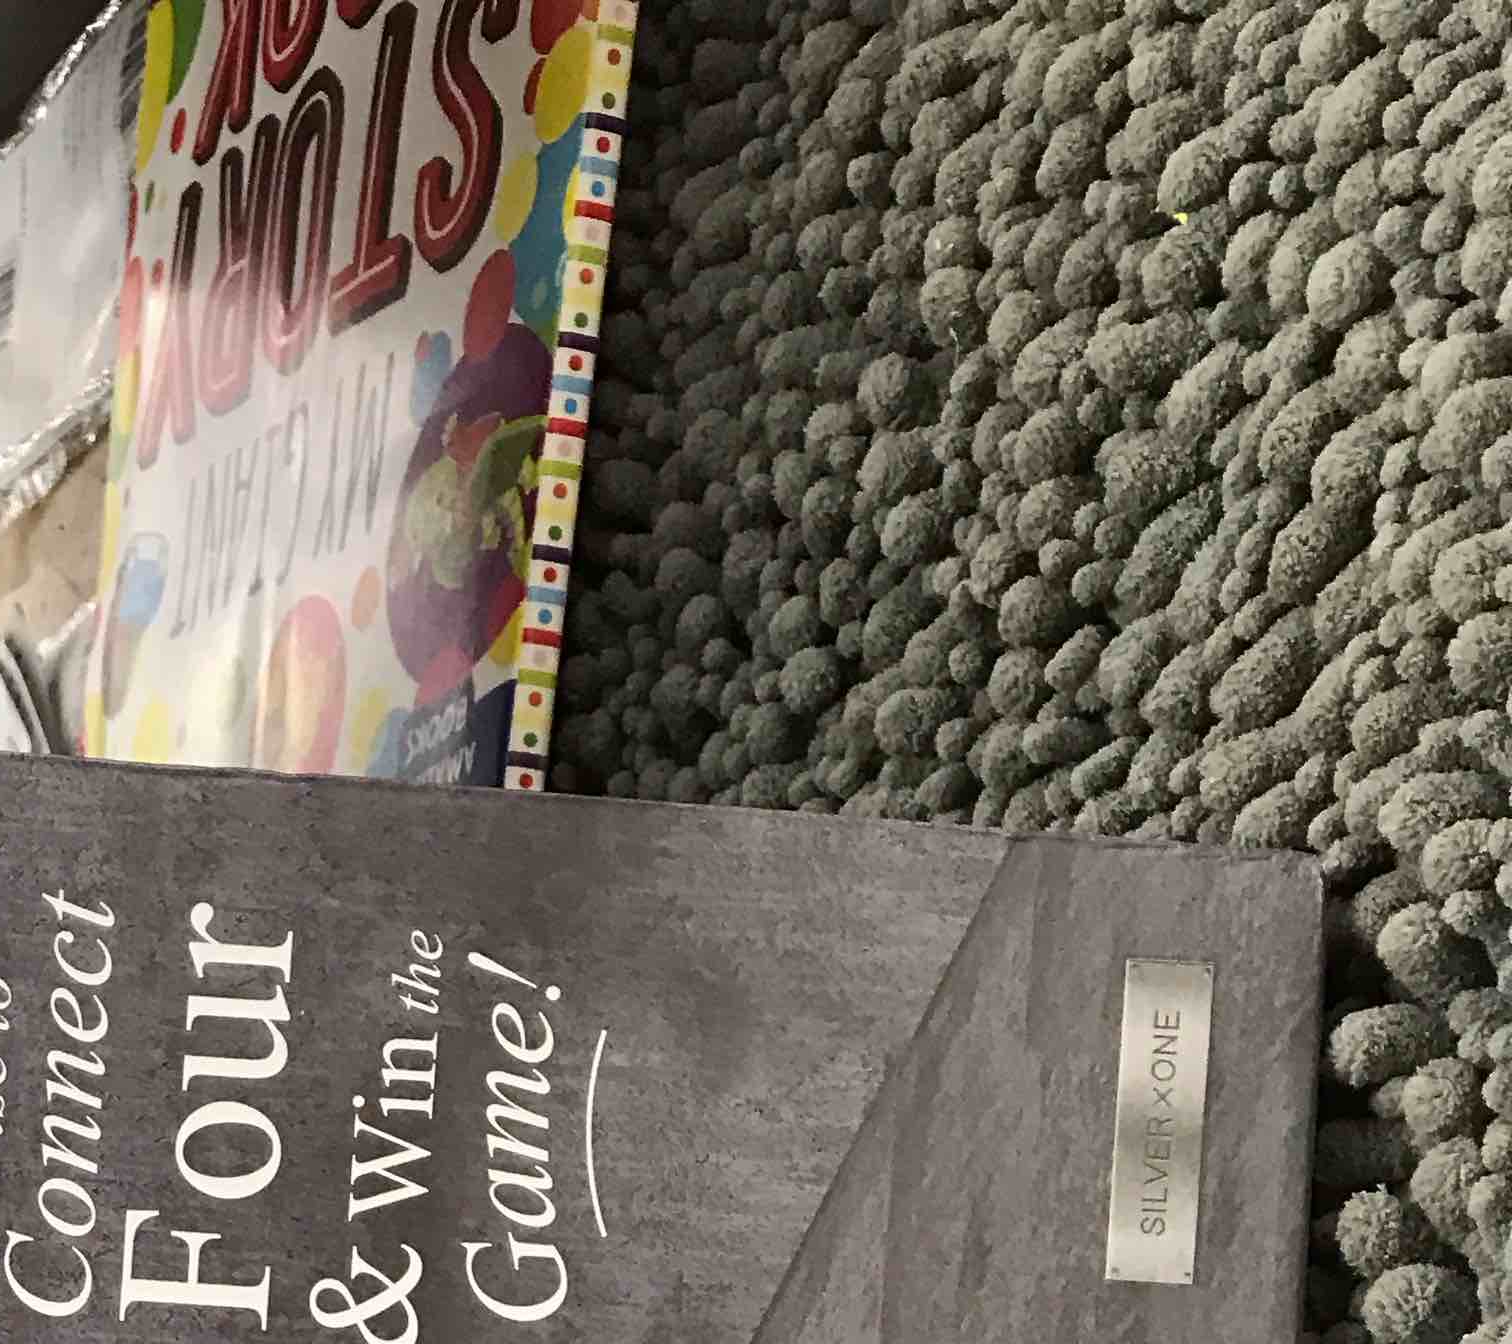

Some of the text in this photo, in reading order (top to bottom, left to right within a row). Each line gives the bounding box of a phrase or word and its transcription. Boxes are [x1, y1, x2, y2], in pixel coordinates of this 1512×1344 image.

[136, 0, 518, 470] STORY
[168, 350, 394, 639] MY GIANT
[3, 888, 116, 1317] Connect
[117, 900, 295, 1331] Four
[346, 1030, 439, 1222] Win
[391, 927, 445, 1015] the
[460, 950, 569, 1322] Game!
